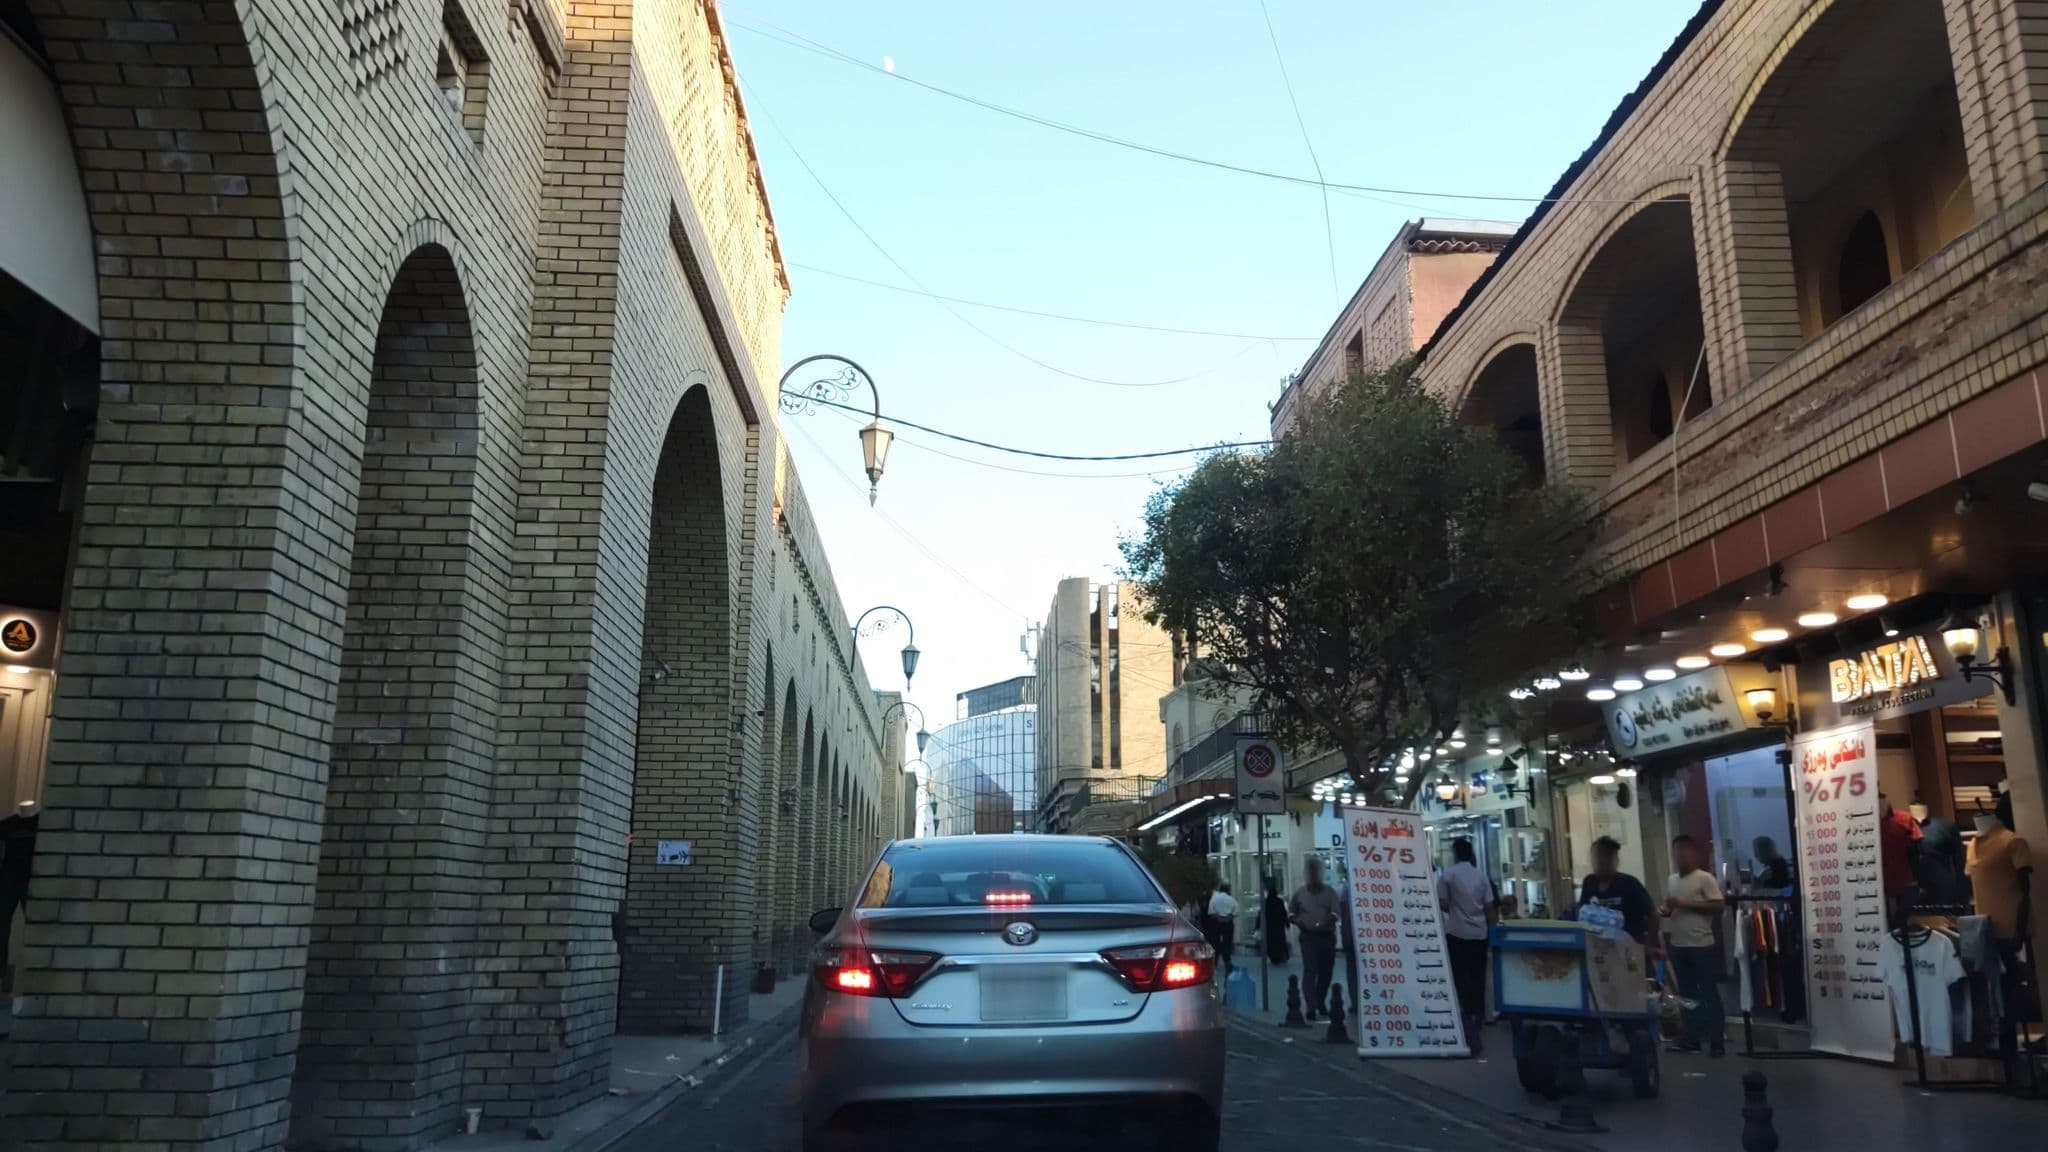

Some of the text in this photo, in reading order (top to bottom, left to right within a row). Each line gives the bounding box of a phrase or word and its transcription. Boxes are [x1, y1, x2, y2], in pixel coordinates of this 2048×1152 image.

[1804, 772, 1867, 804] %75
[1358, 845, 1415, 864] %75
[1370, 869, 1391, 879] 000
[1355, 883, 1368, 892] 15
[1371, 884, 1392, 894] 000
[1356, 898, 1369, 908] 20
[1373, 899, 1394, 909] 000
[1358, 913, 1371, 922] 15
[1375, 913, 1396, 923] 000
[1359, 929, 1372, 938] 20
[1376, 929, 1398, 938] 000
[1360, 944, 1400, 953] 20 000
[1362, 959, 1402, 969] 15 000
[1364, 975, 1405, 984] 15 000
[1363, 989, 1395, 1000] $ 47
[1363, 1005, 1409, 1015] 25 000
[1365, 1021, 1381, 1031] 40
[1386, 1021, 1412, 1031] 000
[1370, 1036, 1404, 1047] $ 75
